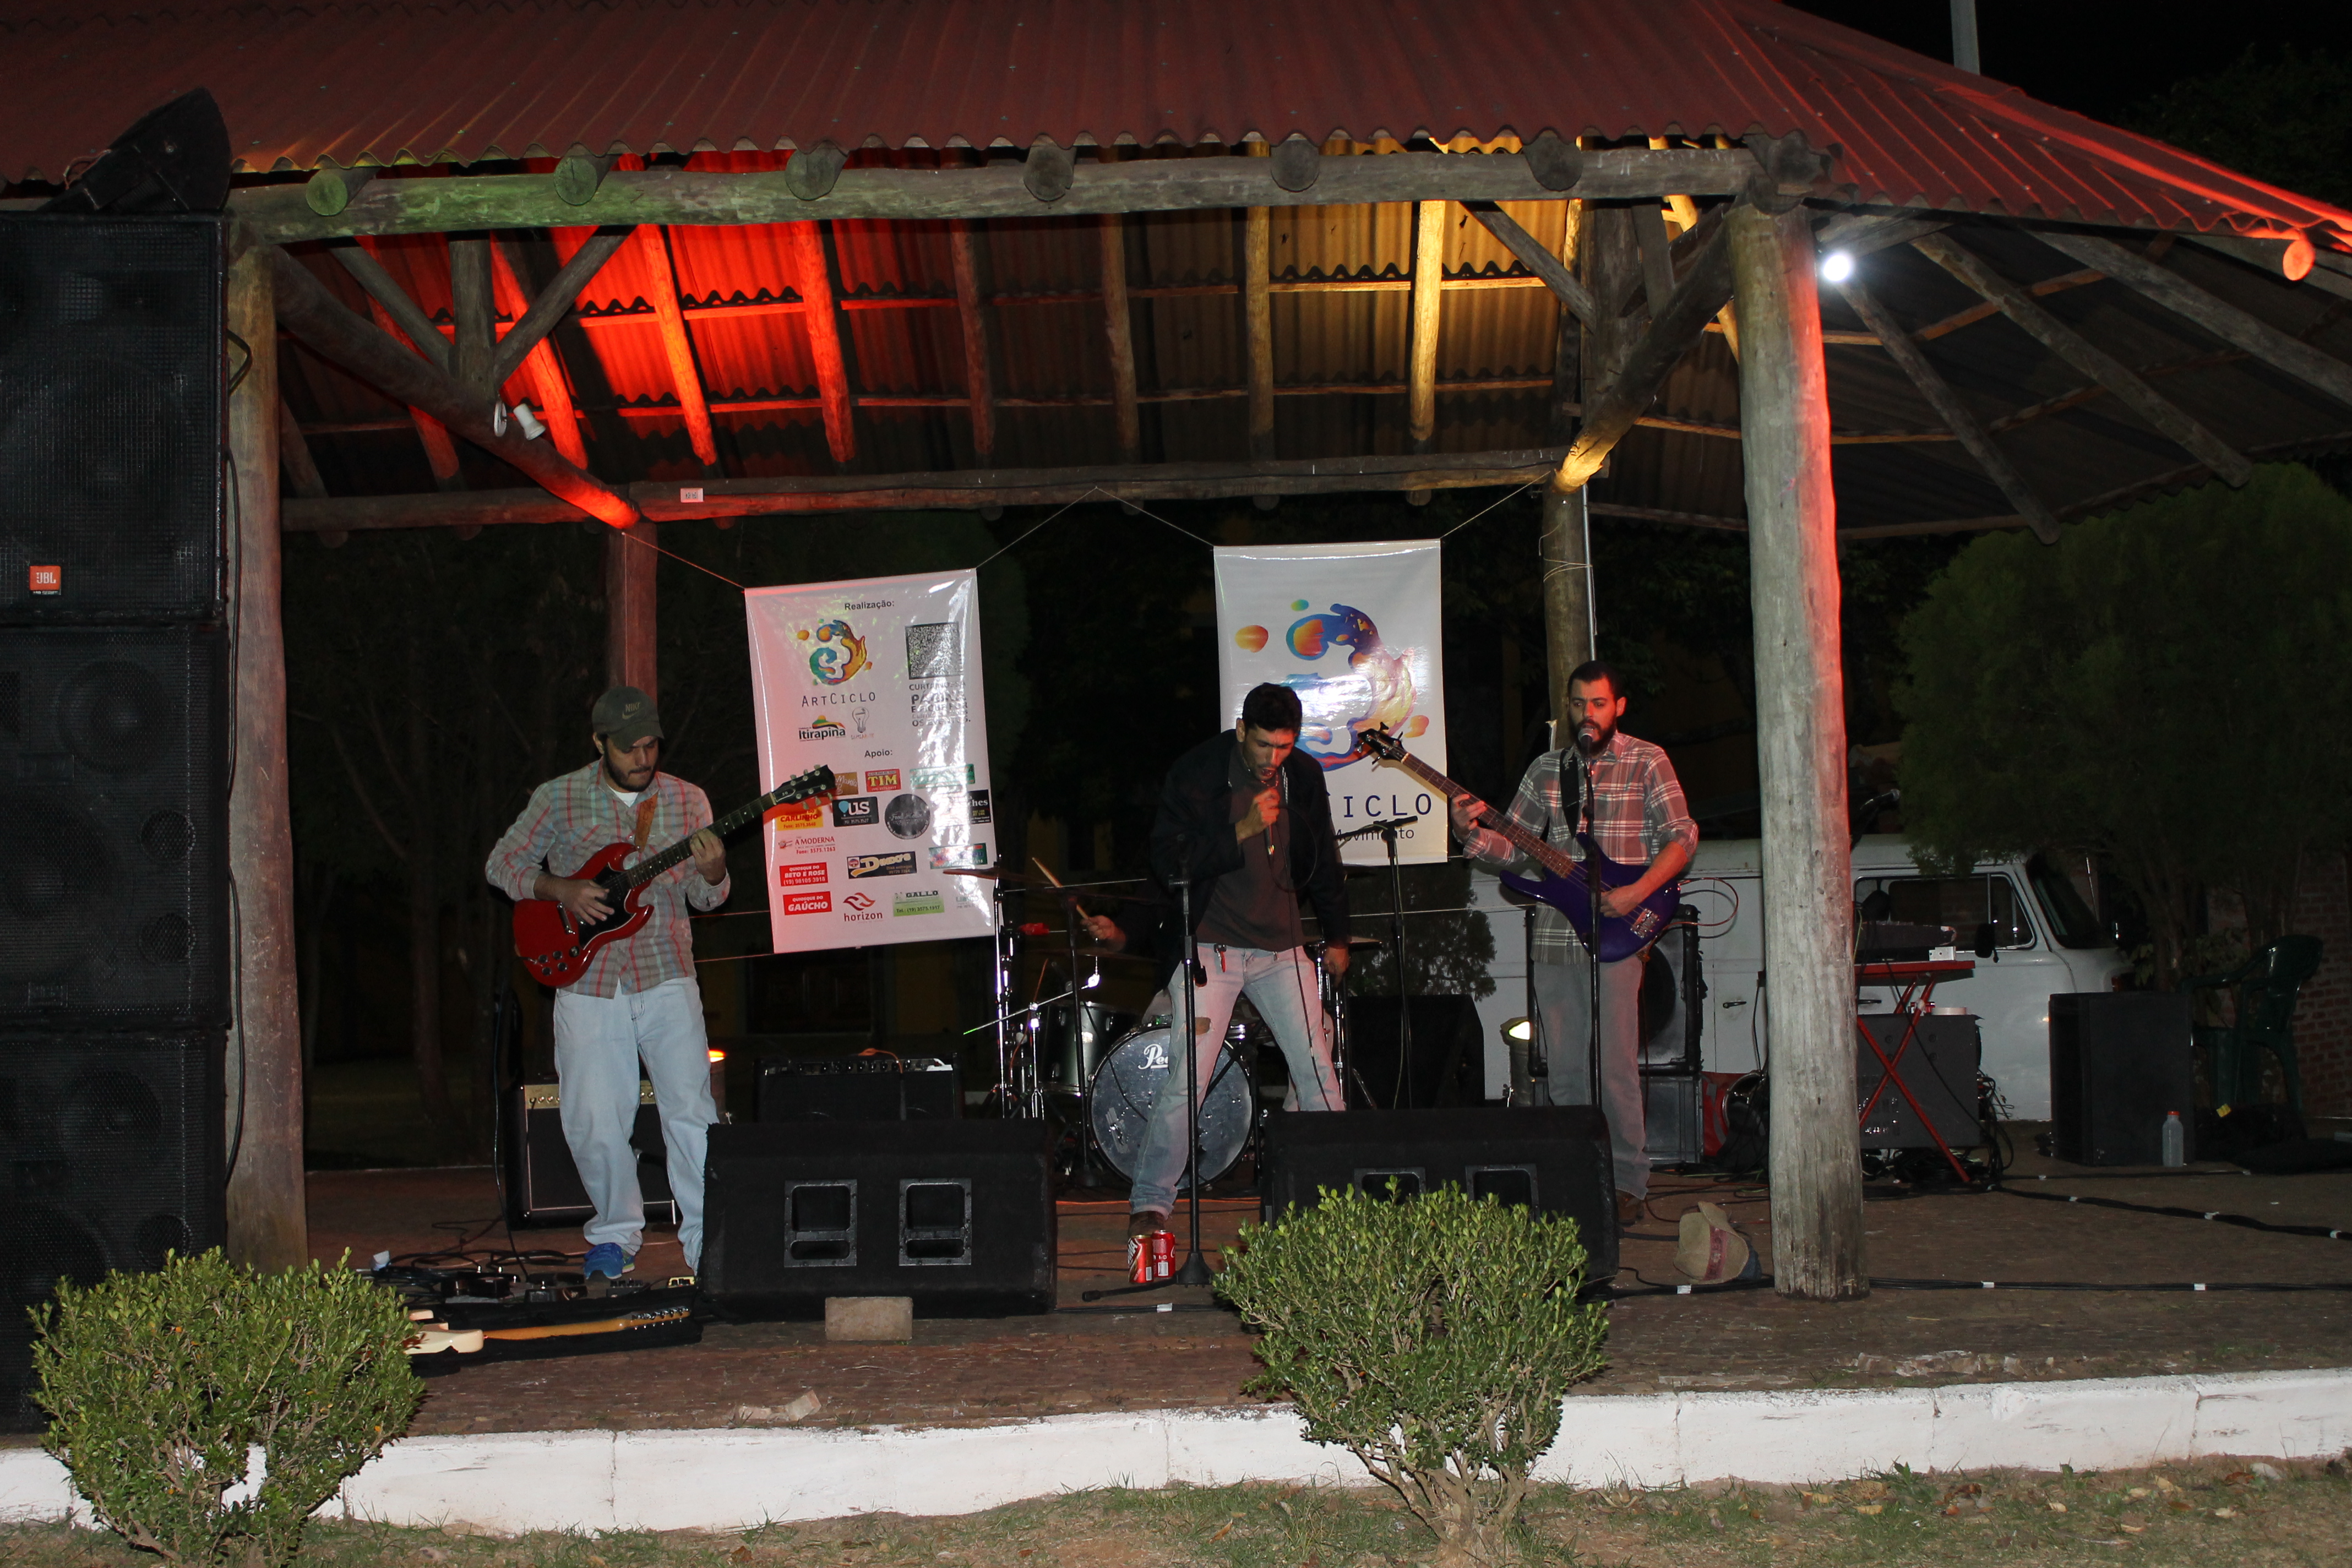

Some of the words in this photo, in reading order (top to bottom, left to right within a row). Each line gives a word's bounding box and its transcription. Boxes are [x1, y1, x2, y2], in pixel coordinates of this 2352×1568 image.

[36, 572, 56, 584] JBL
[845, 600, 894, 610] Realização:
[799, 727, 846, 740] Itirapina
[864, 749, 892, 759] Apoio:
[868, 774, 897, 787] TIM
[1326, 793, 1431, 818] ICLO
[780, 814, 818, 822] CARLINHO
[801, 836, 835, 845] MODERNA
[788, 901, 828, 912] GAÚCHO
[844, 912, 883, 922] horizon
